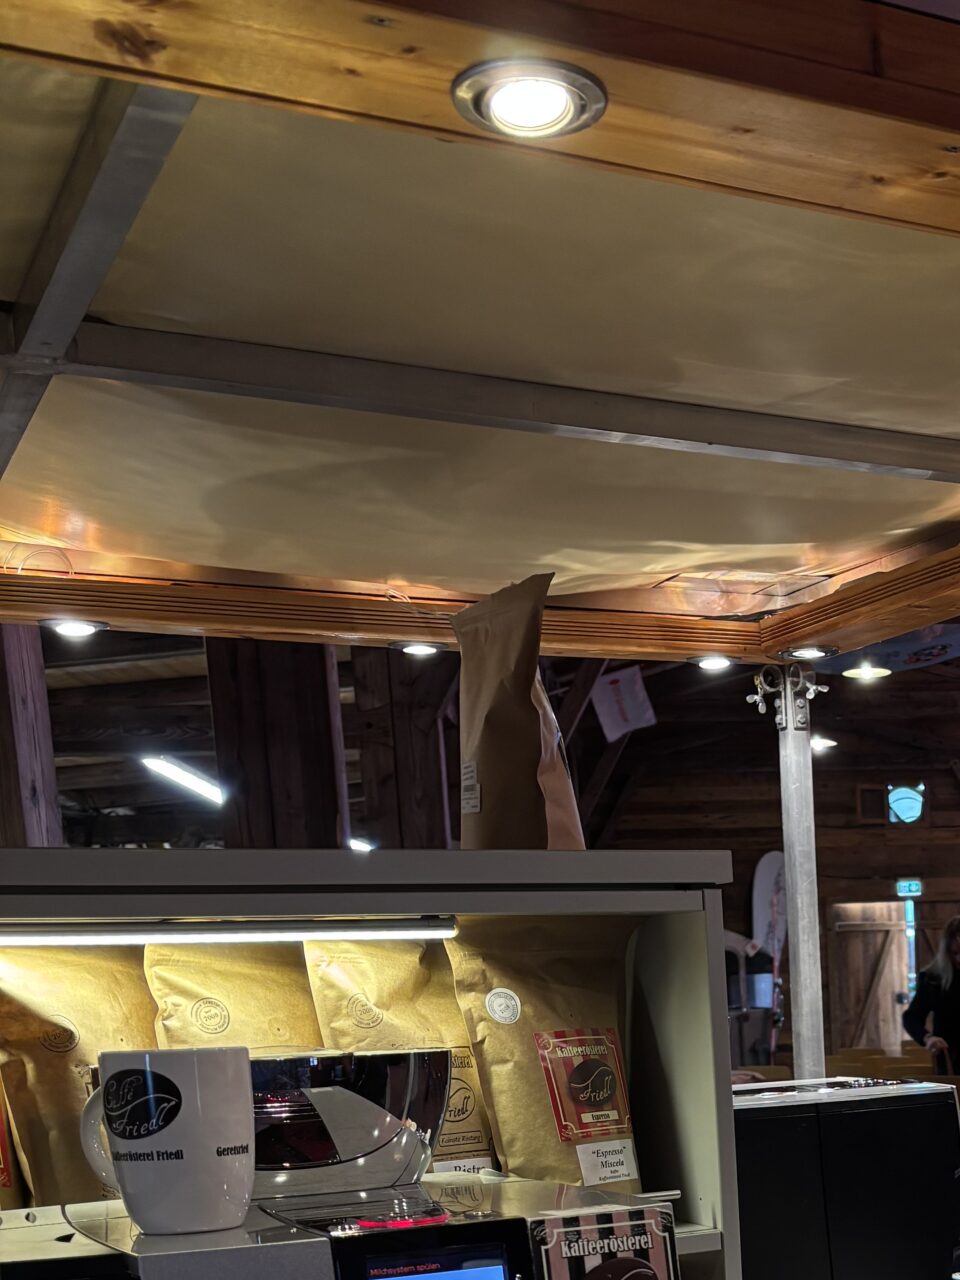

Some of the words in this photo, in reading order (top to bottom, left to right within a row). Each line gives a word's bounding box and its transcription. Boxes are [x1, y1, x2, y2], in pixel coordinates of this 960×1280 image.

[156, 1149, 184, 1161] Friedl
[600, 1159, 625, 1169] Miscela
[560, 1232, 654, 1258] Kaffeerösterei
